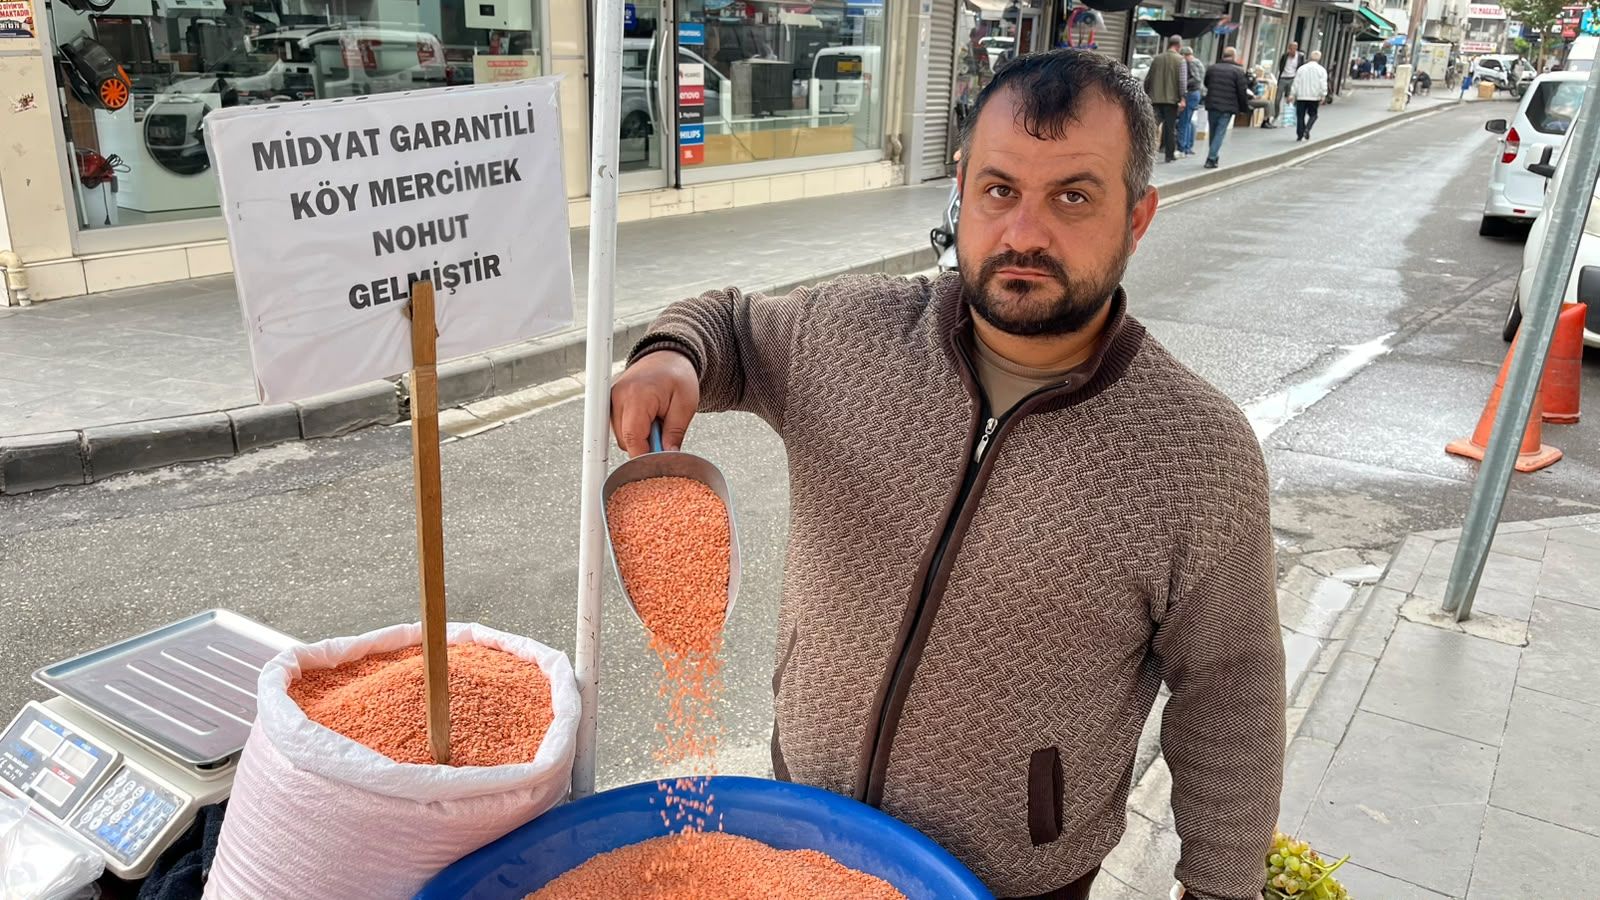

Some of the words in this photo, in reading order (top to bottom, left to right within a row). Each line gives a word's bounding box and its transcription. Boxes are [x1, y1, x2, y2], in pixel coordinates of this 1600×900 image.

[679, 91, 700, 100] enovo
[252, 128, 380, 171] MİDYAT
[390, 102, 535, 152] GARANTİLİ
[679, 130, 701, 140] HILIPS
[290, 180, 359, 220] KÖY
[368, 158, 522, 207] MERCİMEK
[372, 214, 469, 257] NOHUT
[349, 252, 502, 310] GELMİŞTİR
